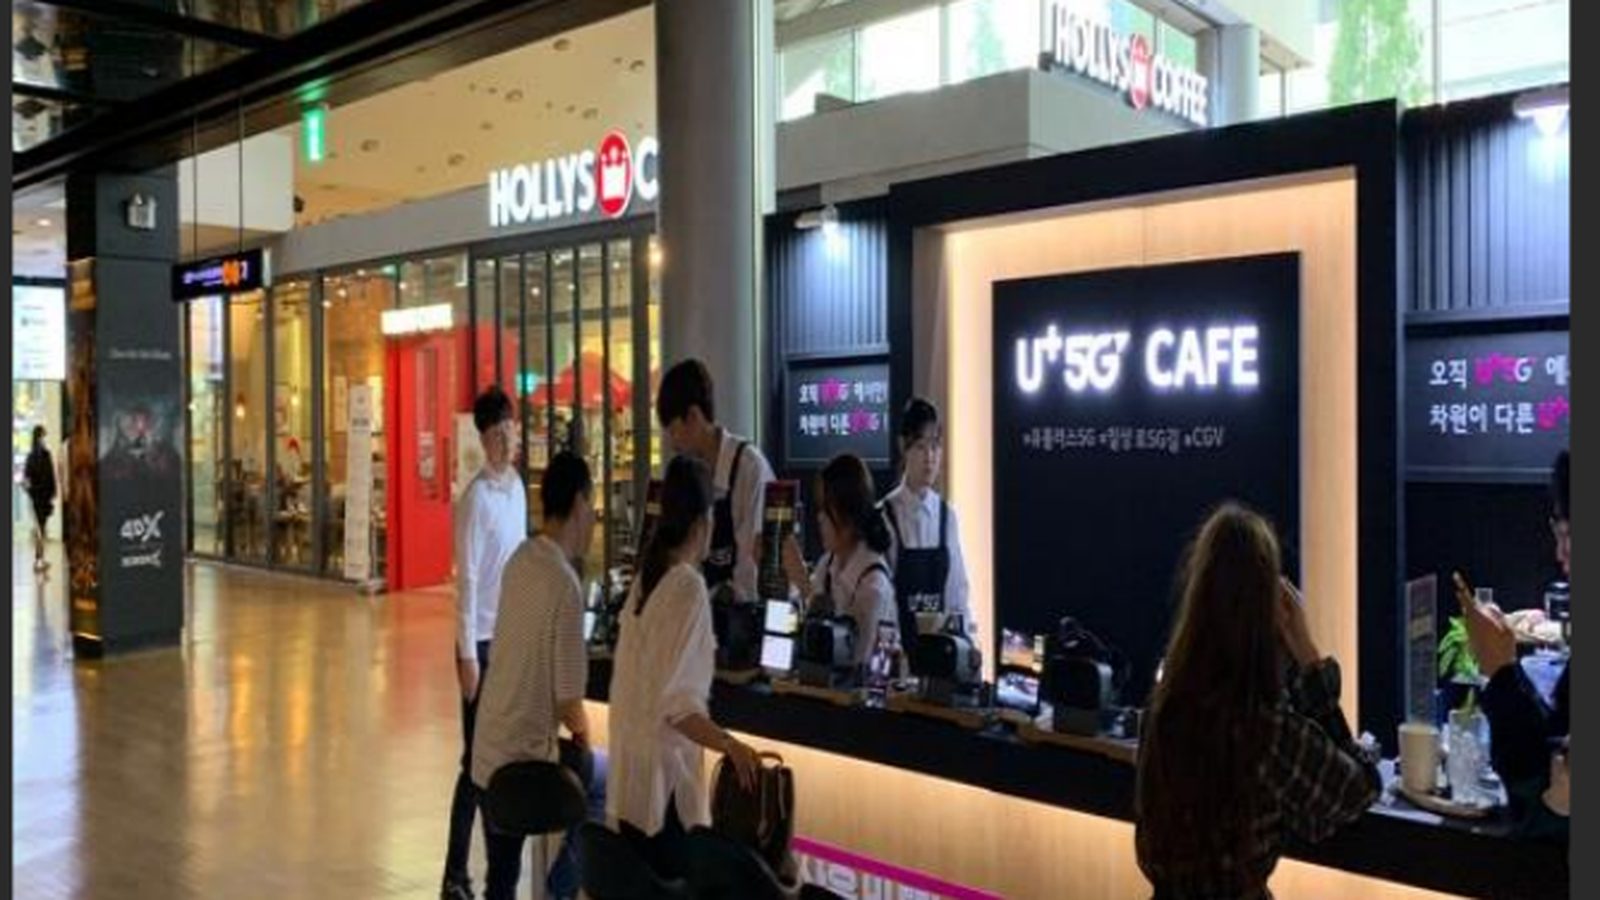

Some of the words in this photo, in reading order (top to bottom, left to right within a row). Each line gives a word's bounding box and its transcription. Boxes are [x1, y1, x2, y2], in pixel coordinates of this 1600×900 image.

[1053, 3, 1132, 92] HOLLYS
[1151, 54, 1207, 127] COFFEE
[489, 149, 597, 228] HOLLYS
[1145, 325, 1259, 388] CAFE
[1429, 358, 1467, 389] 오직
[1430, 402, 1487, 435] 차원이
[1494, 402, 1534, 434] 다른
